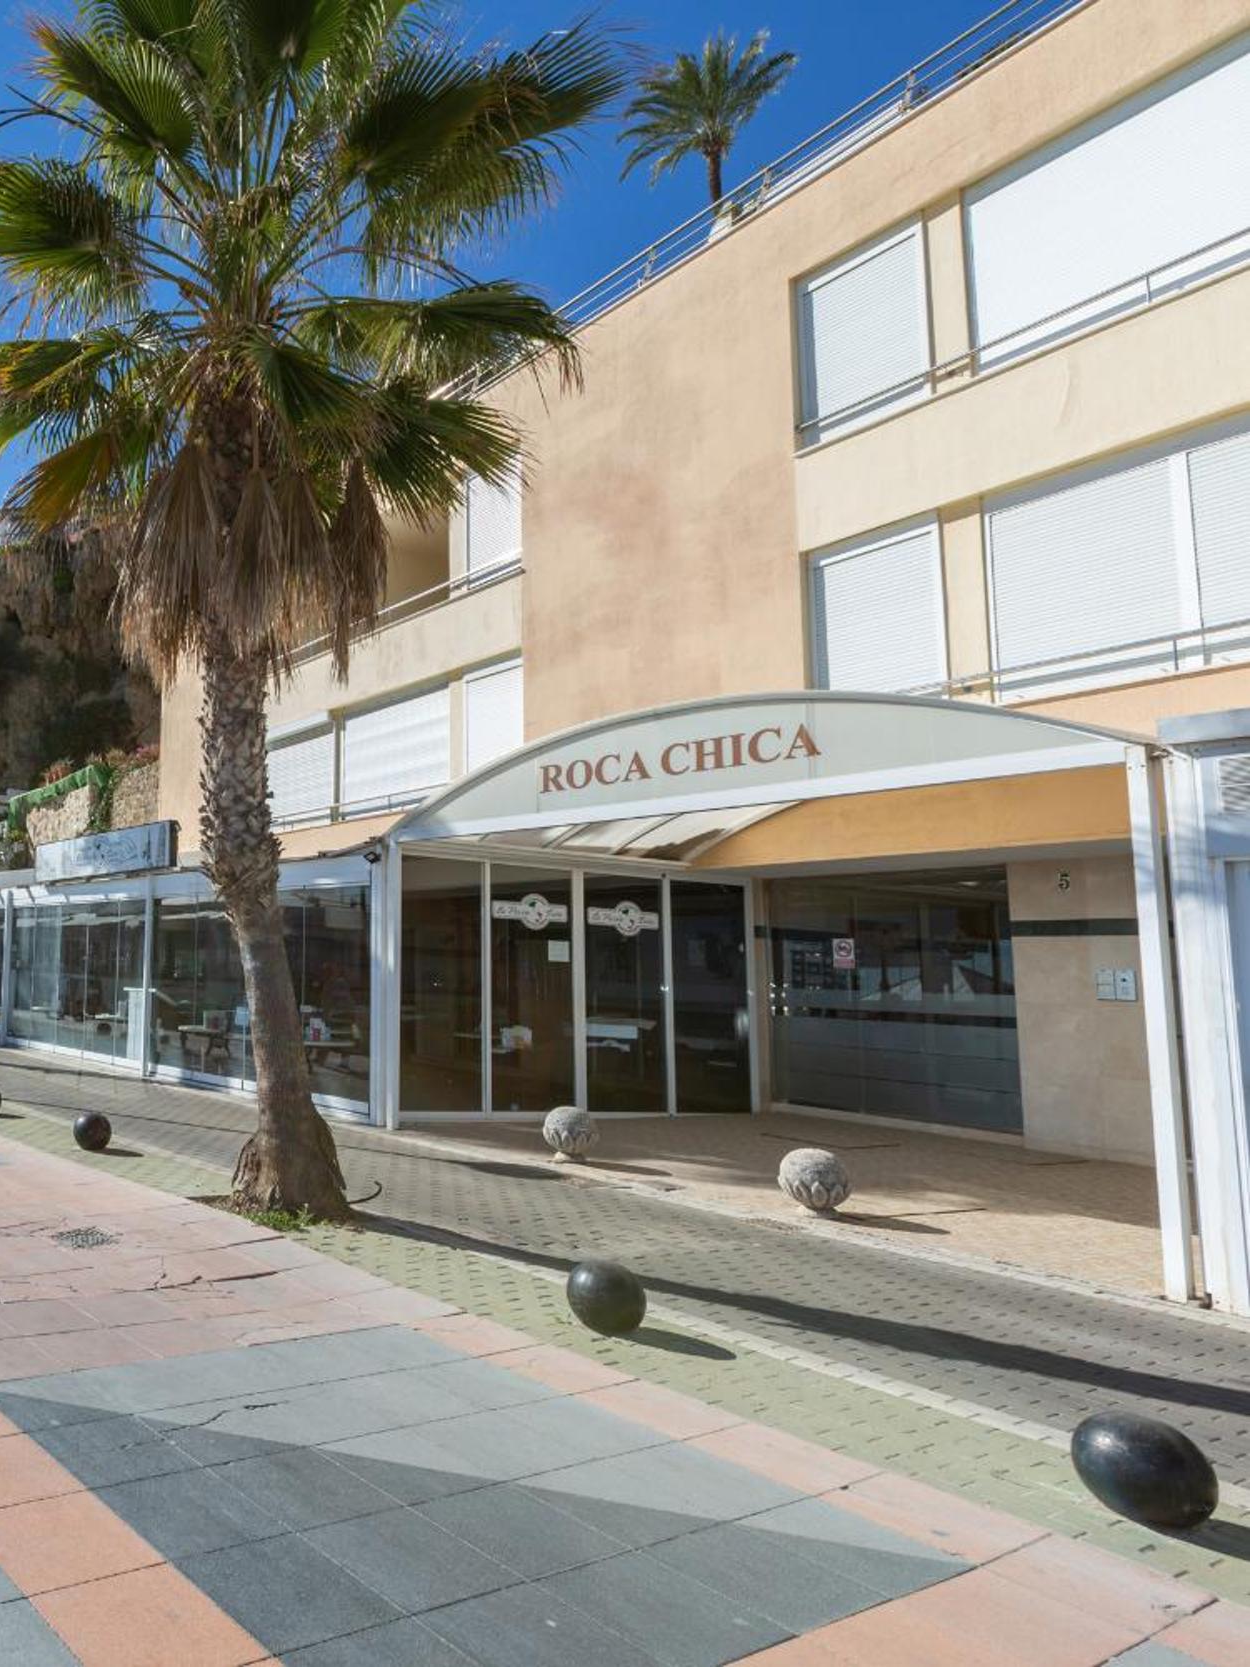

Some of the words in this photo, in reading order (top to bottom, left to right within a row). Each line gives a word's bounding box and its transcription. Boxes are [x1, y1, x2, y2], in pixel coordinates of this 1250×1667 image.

[539, 751, 653, 794] ROCA
[661, 723, 822, 776] CHICA
[1057, 872, 1070, 890] 5
